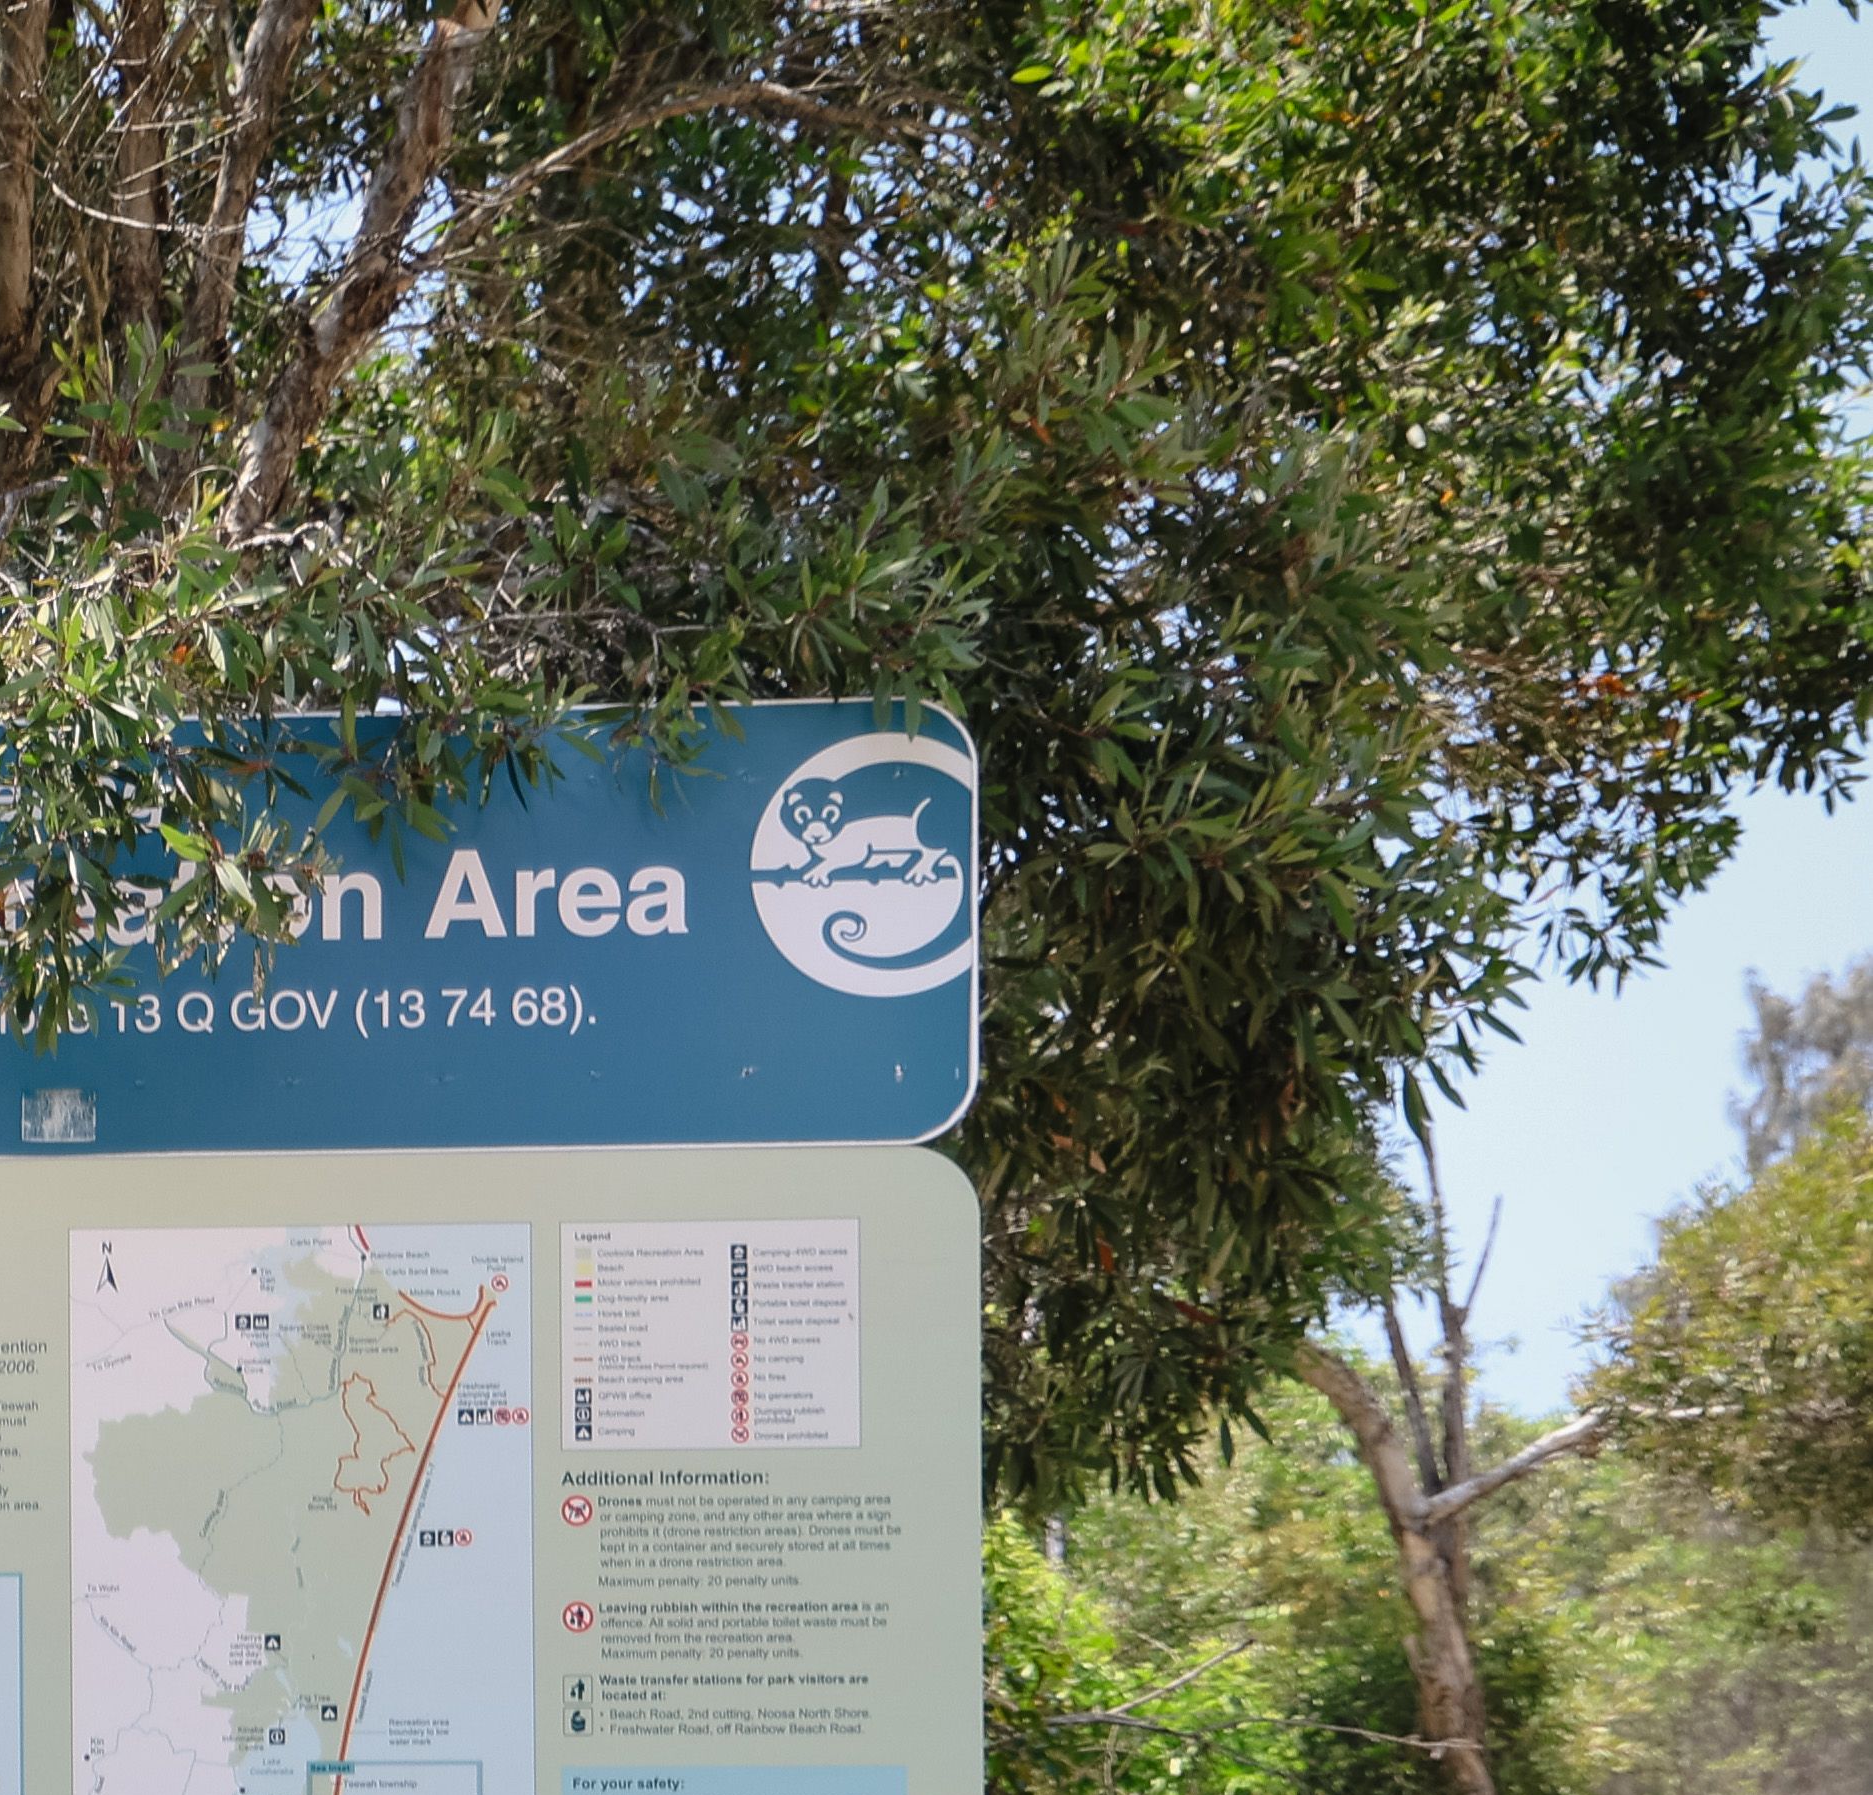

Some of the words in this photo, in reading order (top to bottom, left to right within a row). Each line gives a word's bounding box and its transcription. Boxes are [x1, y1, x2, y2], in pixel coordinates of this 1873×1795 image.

[424, 849, 688, 939] Area
[112, 993, 162, 1034] 13
[177, 991, 213, 1033] Q
[230, 990, 338, 1033] GOV
[355, 989, 424, 1039] (13
[441, 988, 495, 1027] 74
[512, 985, 595, 1035] 68).
[101, 1242, 111, 1254] N
[561, 1471, 652, 1486] Additional
[660, 1470, 767, 1485] Information:
[572, 1778, 595, 1790] For
[600, 1780, 631, 1792] your
[637, 1777, 682, 1792] safety:
